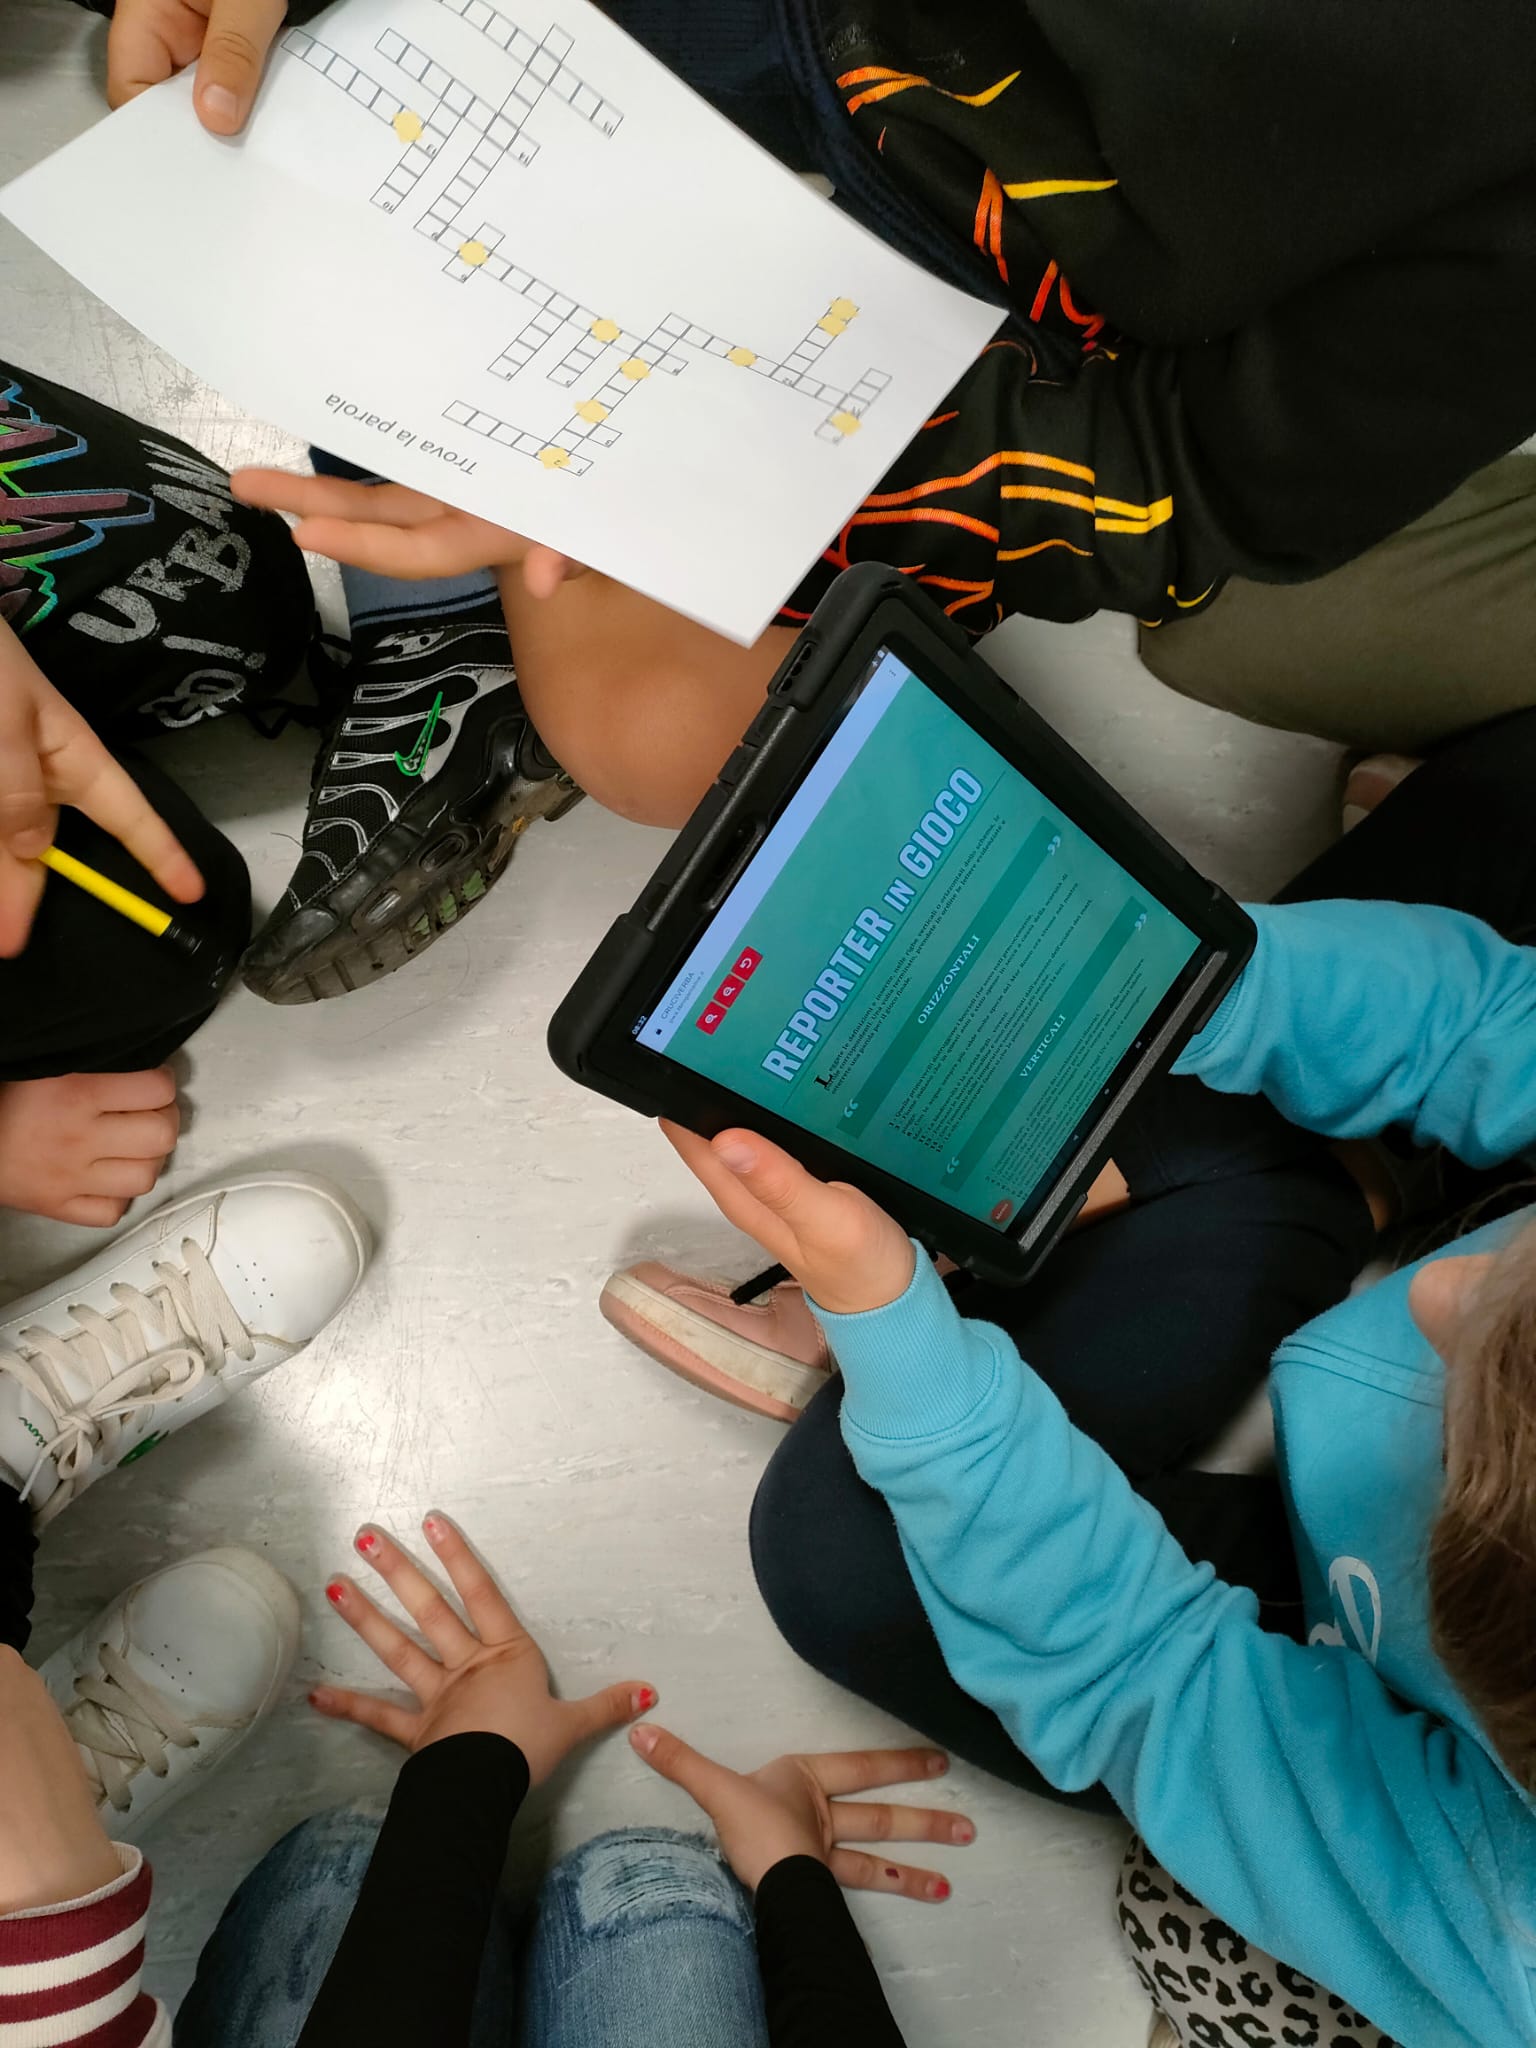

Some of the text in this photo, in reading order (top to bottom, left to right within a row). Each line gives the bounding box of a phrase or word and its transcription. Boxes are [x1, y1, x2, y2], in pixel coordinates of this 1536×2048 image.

[325, 393, 478, 475] Trova la parola
[759, 764, 985, 1083] REPORTER IN GIOCO
[915, 933, 980, 1025] ORIZZONTALI
[1018, 1012, 1067, 1079] VERTICALI
